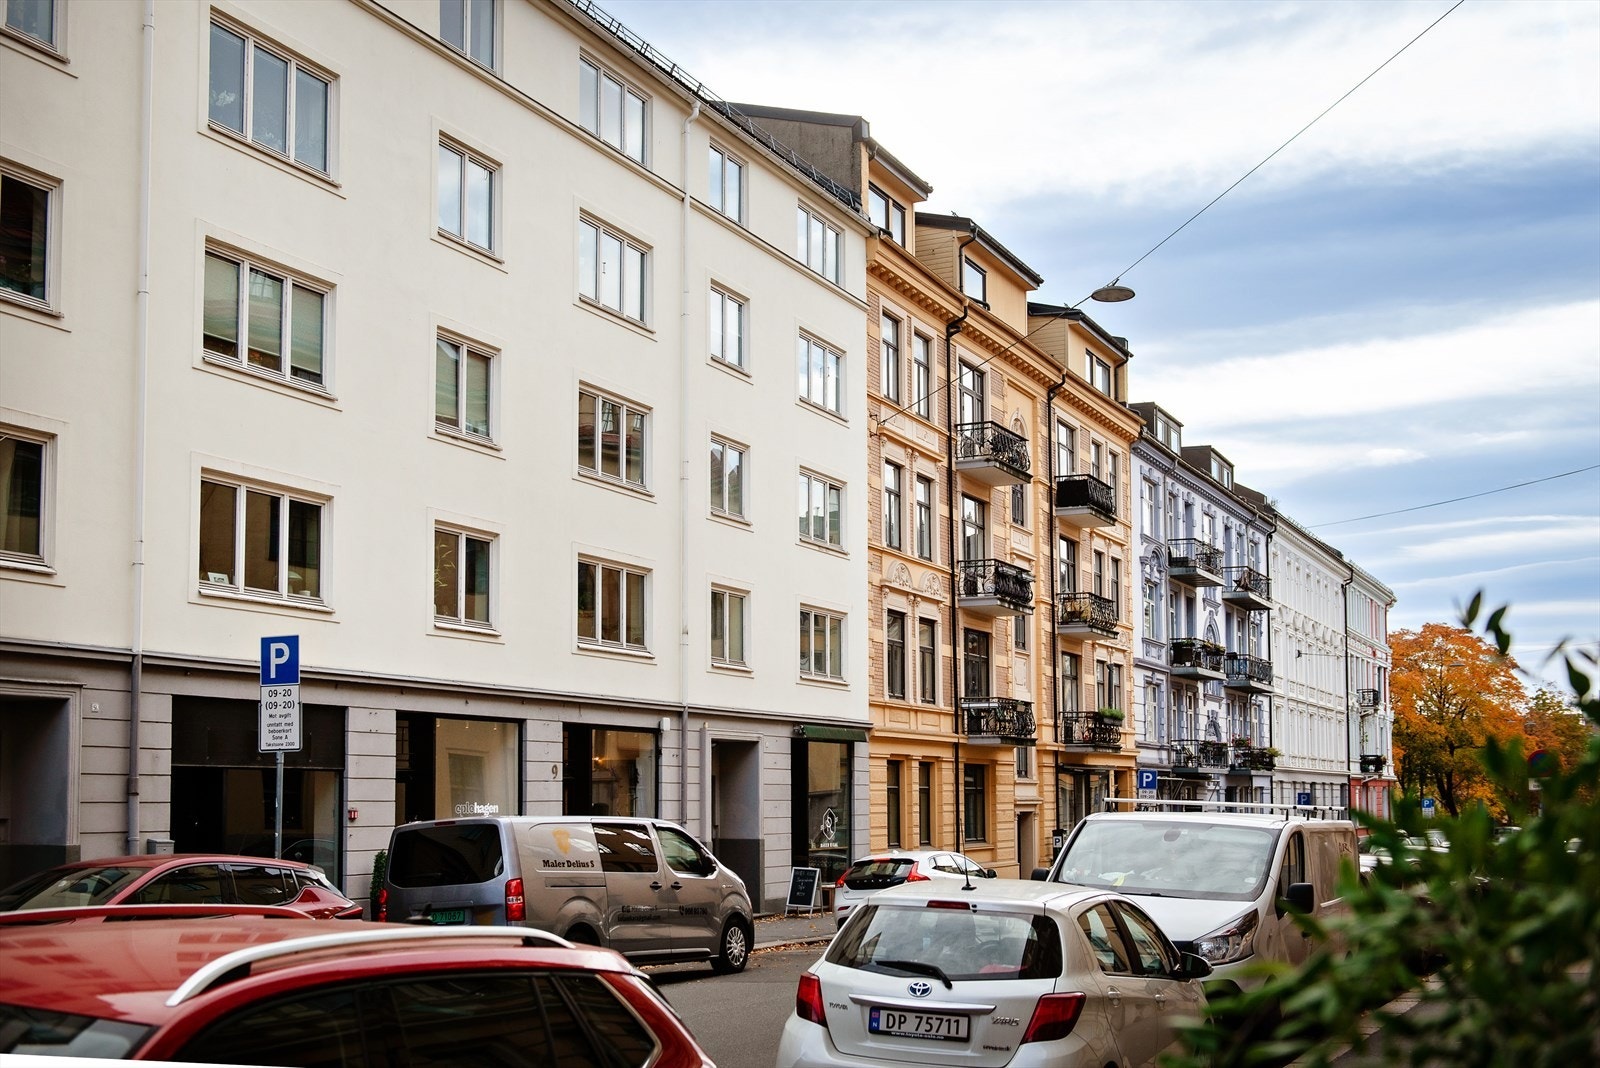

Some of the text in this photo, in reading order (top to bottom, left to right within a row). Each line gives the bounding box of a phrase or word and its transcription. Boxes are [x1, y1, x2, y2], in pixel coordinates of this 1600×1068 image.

[270, 642, 290, 679] P
[552, 764, 558, 780] 9
[1143, 772, 1153, 787] P
[1300, 796, 1308, 804] P
[1424, 800, 1430, 808] P
[1054, 838, 1060, 846] P
[542, 860, 566, 868] Maler
[566, 860, 590, 868] Delius
[885, 1012, 907, 1031] DP
[914, 1015, 960, 1036] 75711
